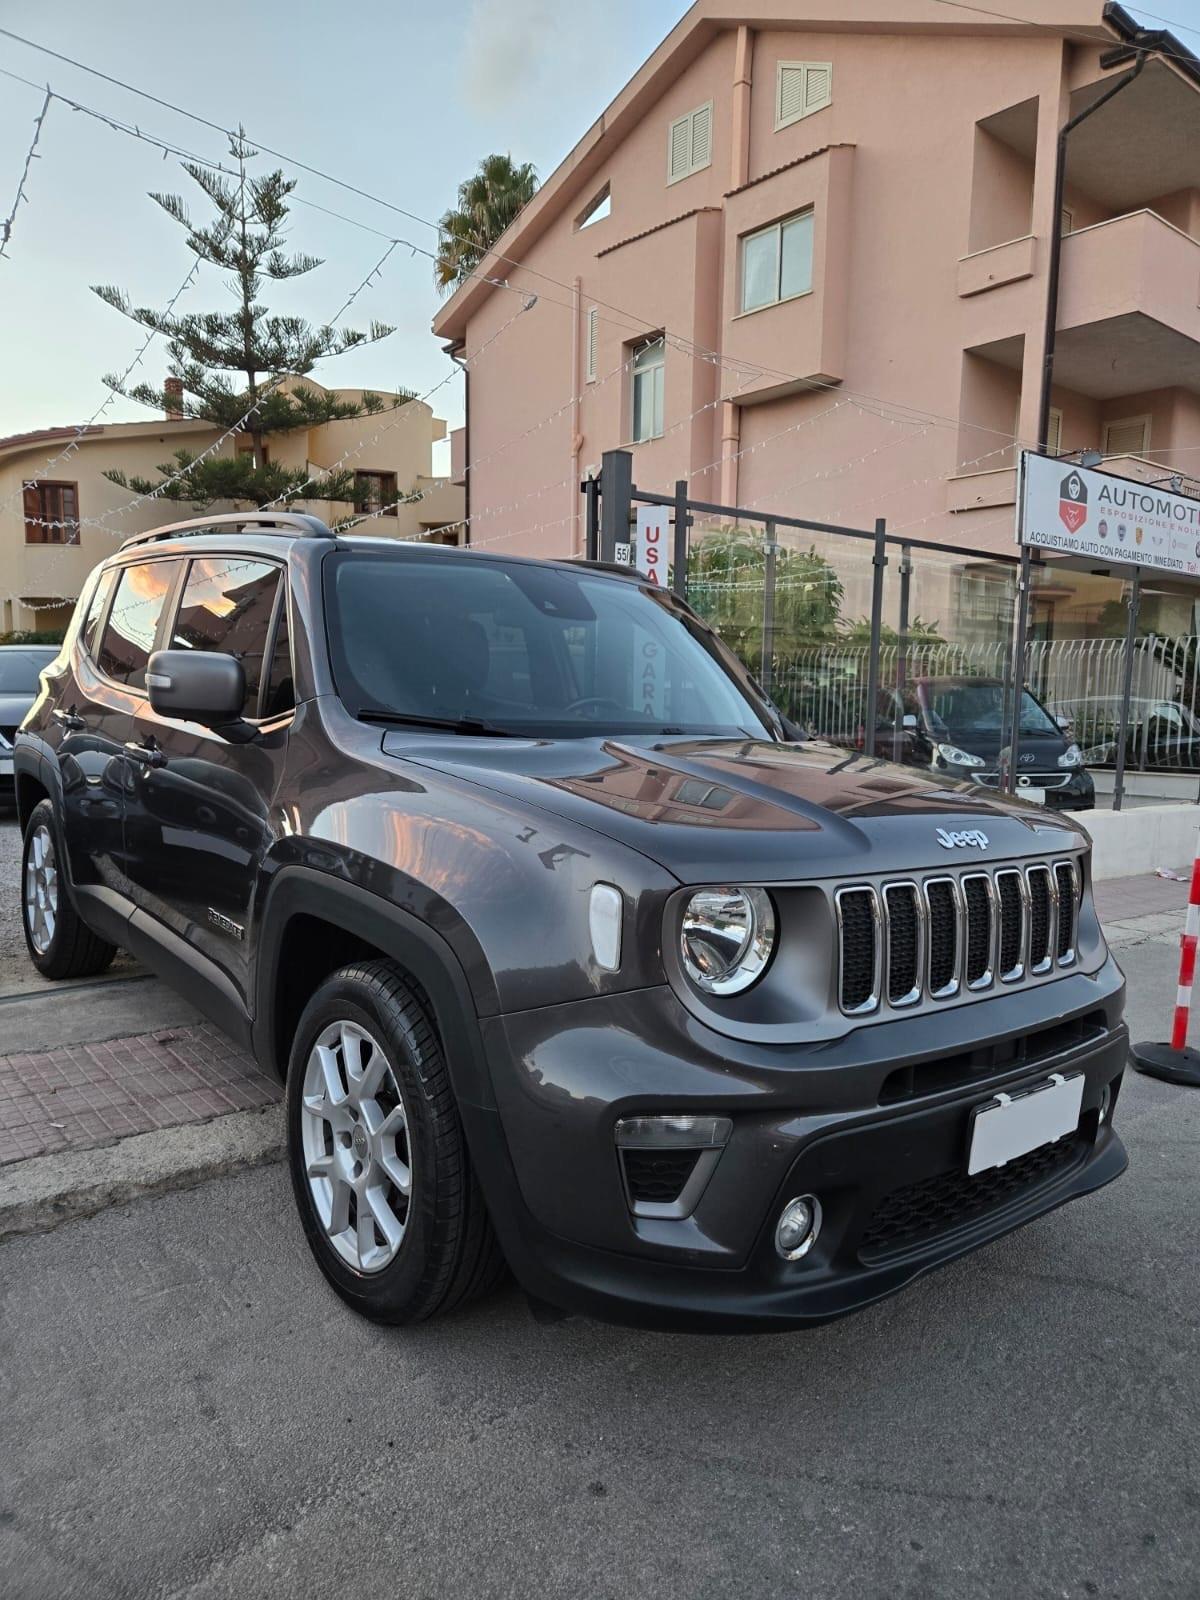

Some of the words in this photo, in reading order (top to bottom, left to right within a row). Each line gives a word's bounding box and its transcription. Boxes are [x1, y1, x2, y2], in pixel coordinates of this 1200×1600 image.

[1100, 506, 1168, 529] ESPOSIZIONE
[645, 526, 660, 585] USA
[1029, 531, 1079, 551] ACQUISTIAMO
[1080, 541, 1099, 554] AUTO
[1100, 544, 1114, 556] CON
[1114, 547, 1153, 563] PAGAMENTO
[936, 828, 989, 850] Jeep
